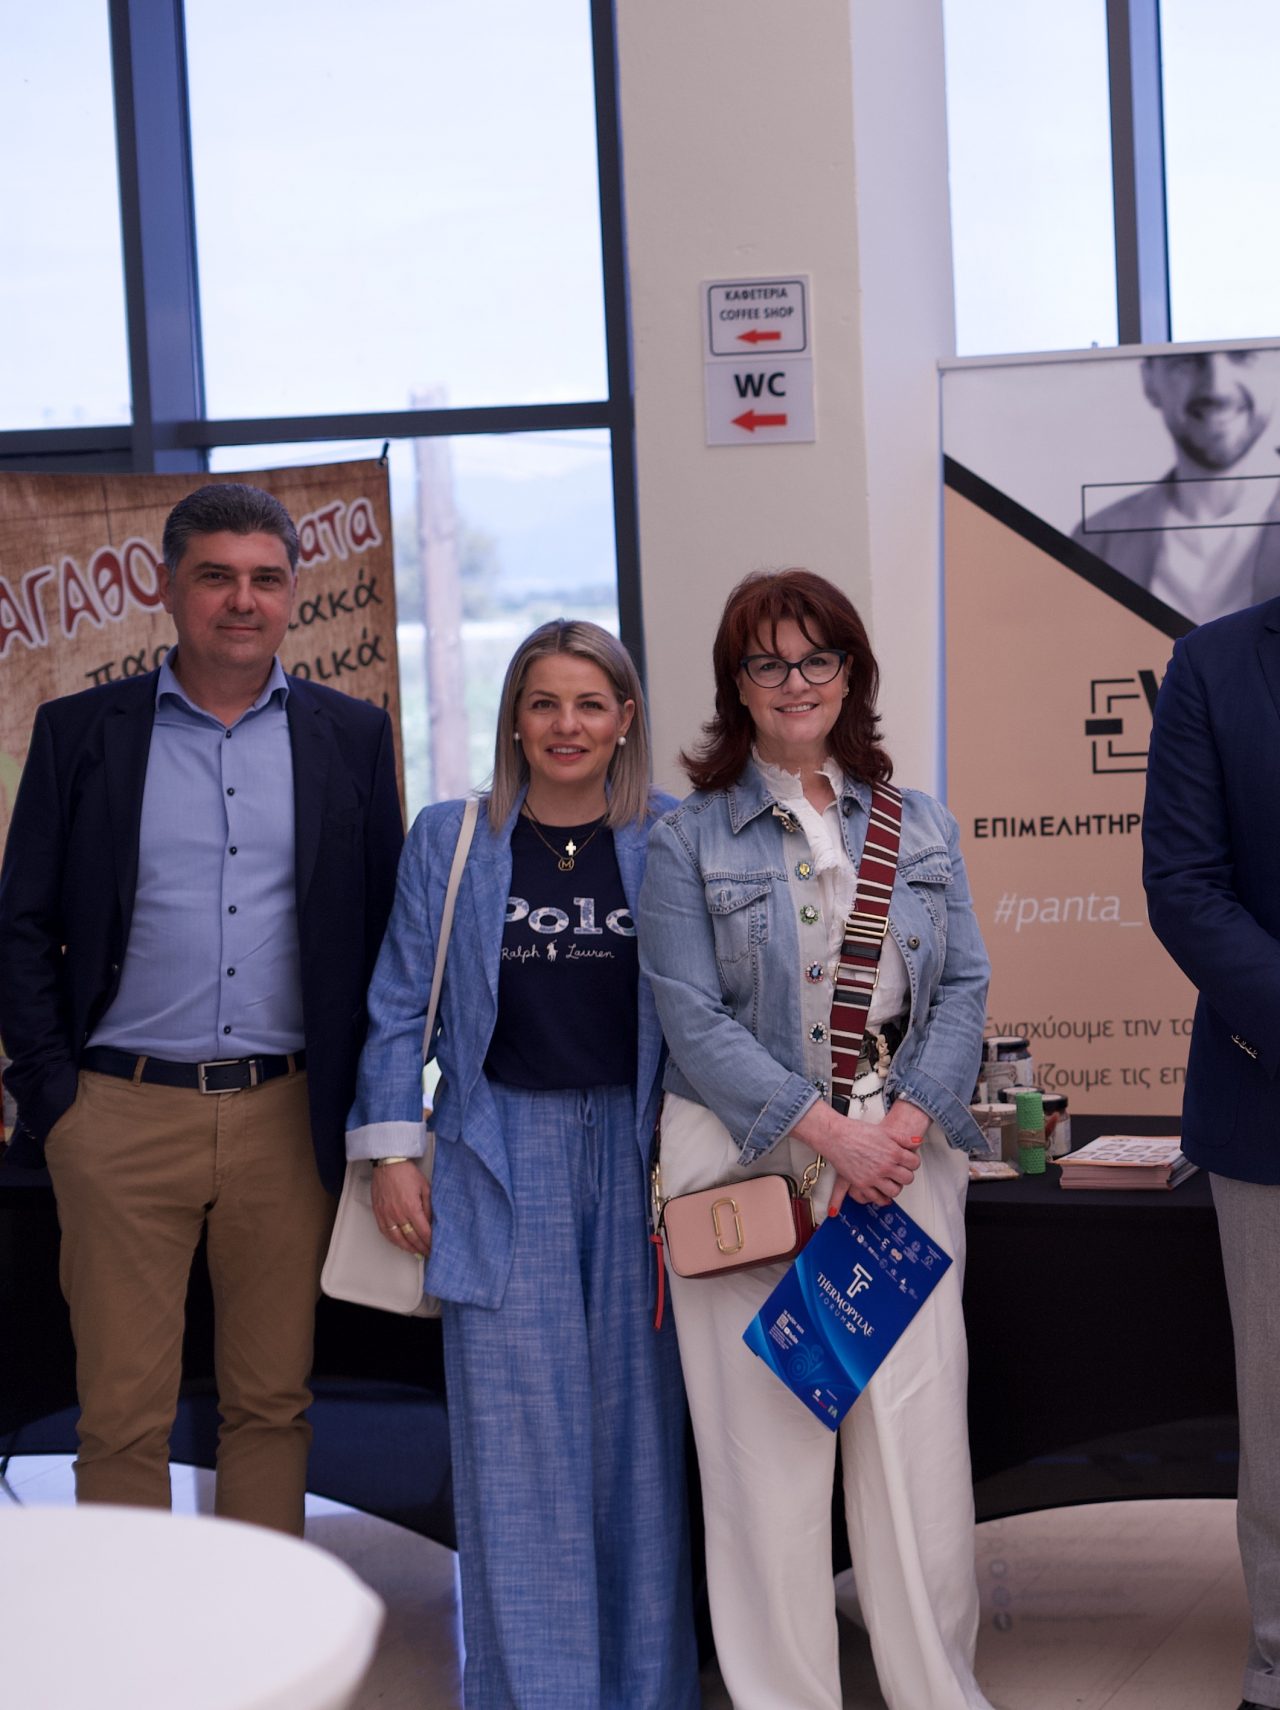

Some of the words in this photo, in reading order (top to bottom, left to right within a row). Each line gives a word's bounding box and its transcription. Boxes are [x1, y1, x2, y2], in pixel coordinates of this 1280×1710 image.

[720, 307, 760, 321] COFFEE
[764, 305, 794, 319] SHOP
[734, 372, 786, 398] WC
[0, 538, 165, 658] ΑΓΑΘΟ
[288, 567, 382, 629] ακά
[974, 813, 1141, 838] ΕΠΙΜΕΛΗΤΗΡ
[994, 892, 1143, 932] #panta_
[502, 944, 540, 964] Ralph
[565, 943, 615, 960] Lauren
[1122, 1018, 1161, 1036] την
[1169, 1018, 1195, 1036] το
[1033, 1063, 1112, 1092] ίζουμε
[1120, 1067, 1151, 1089] τις
[1159, 1066, 1187, 1085] επ
[817, 1271, 875, 1337] THERMOPYLAE
[819, 1292, 846, 1323] FORUM
